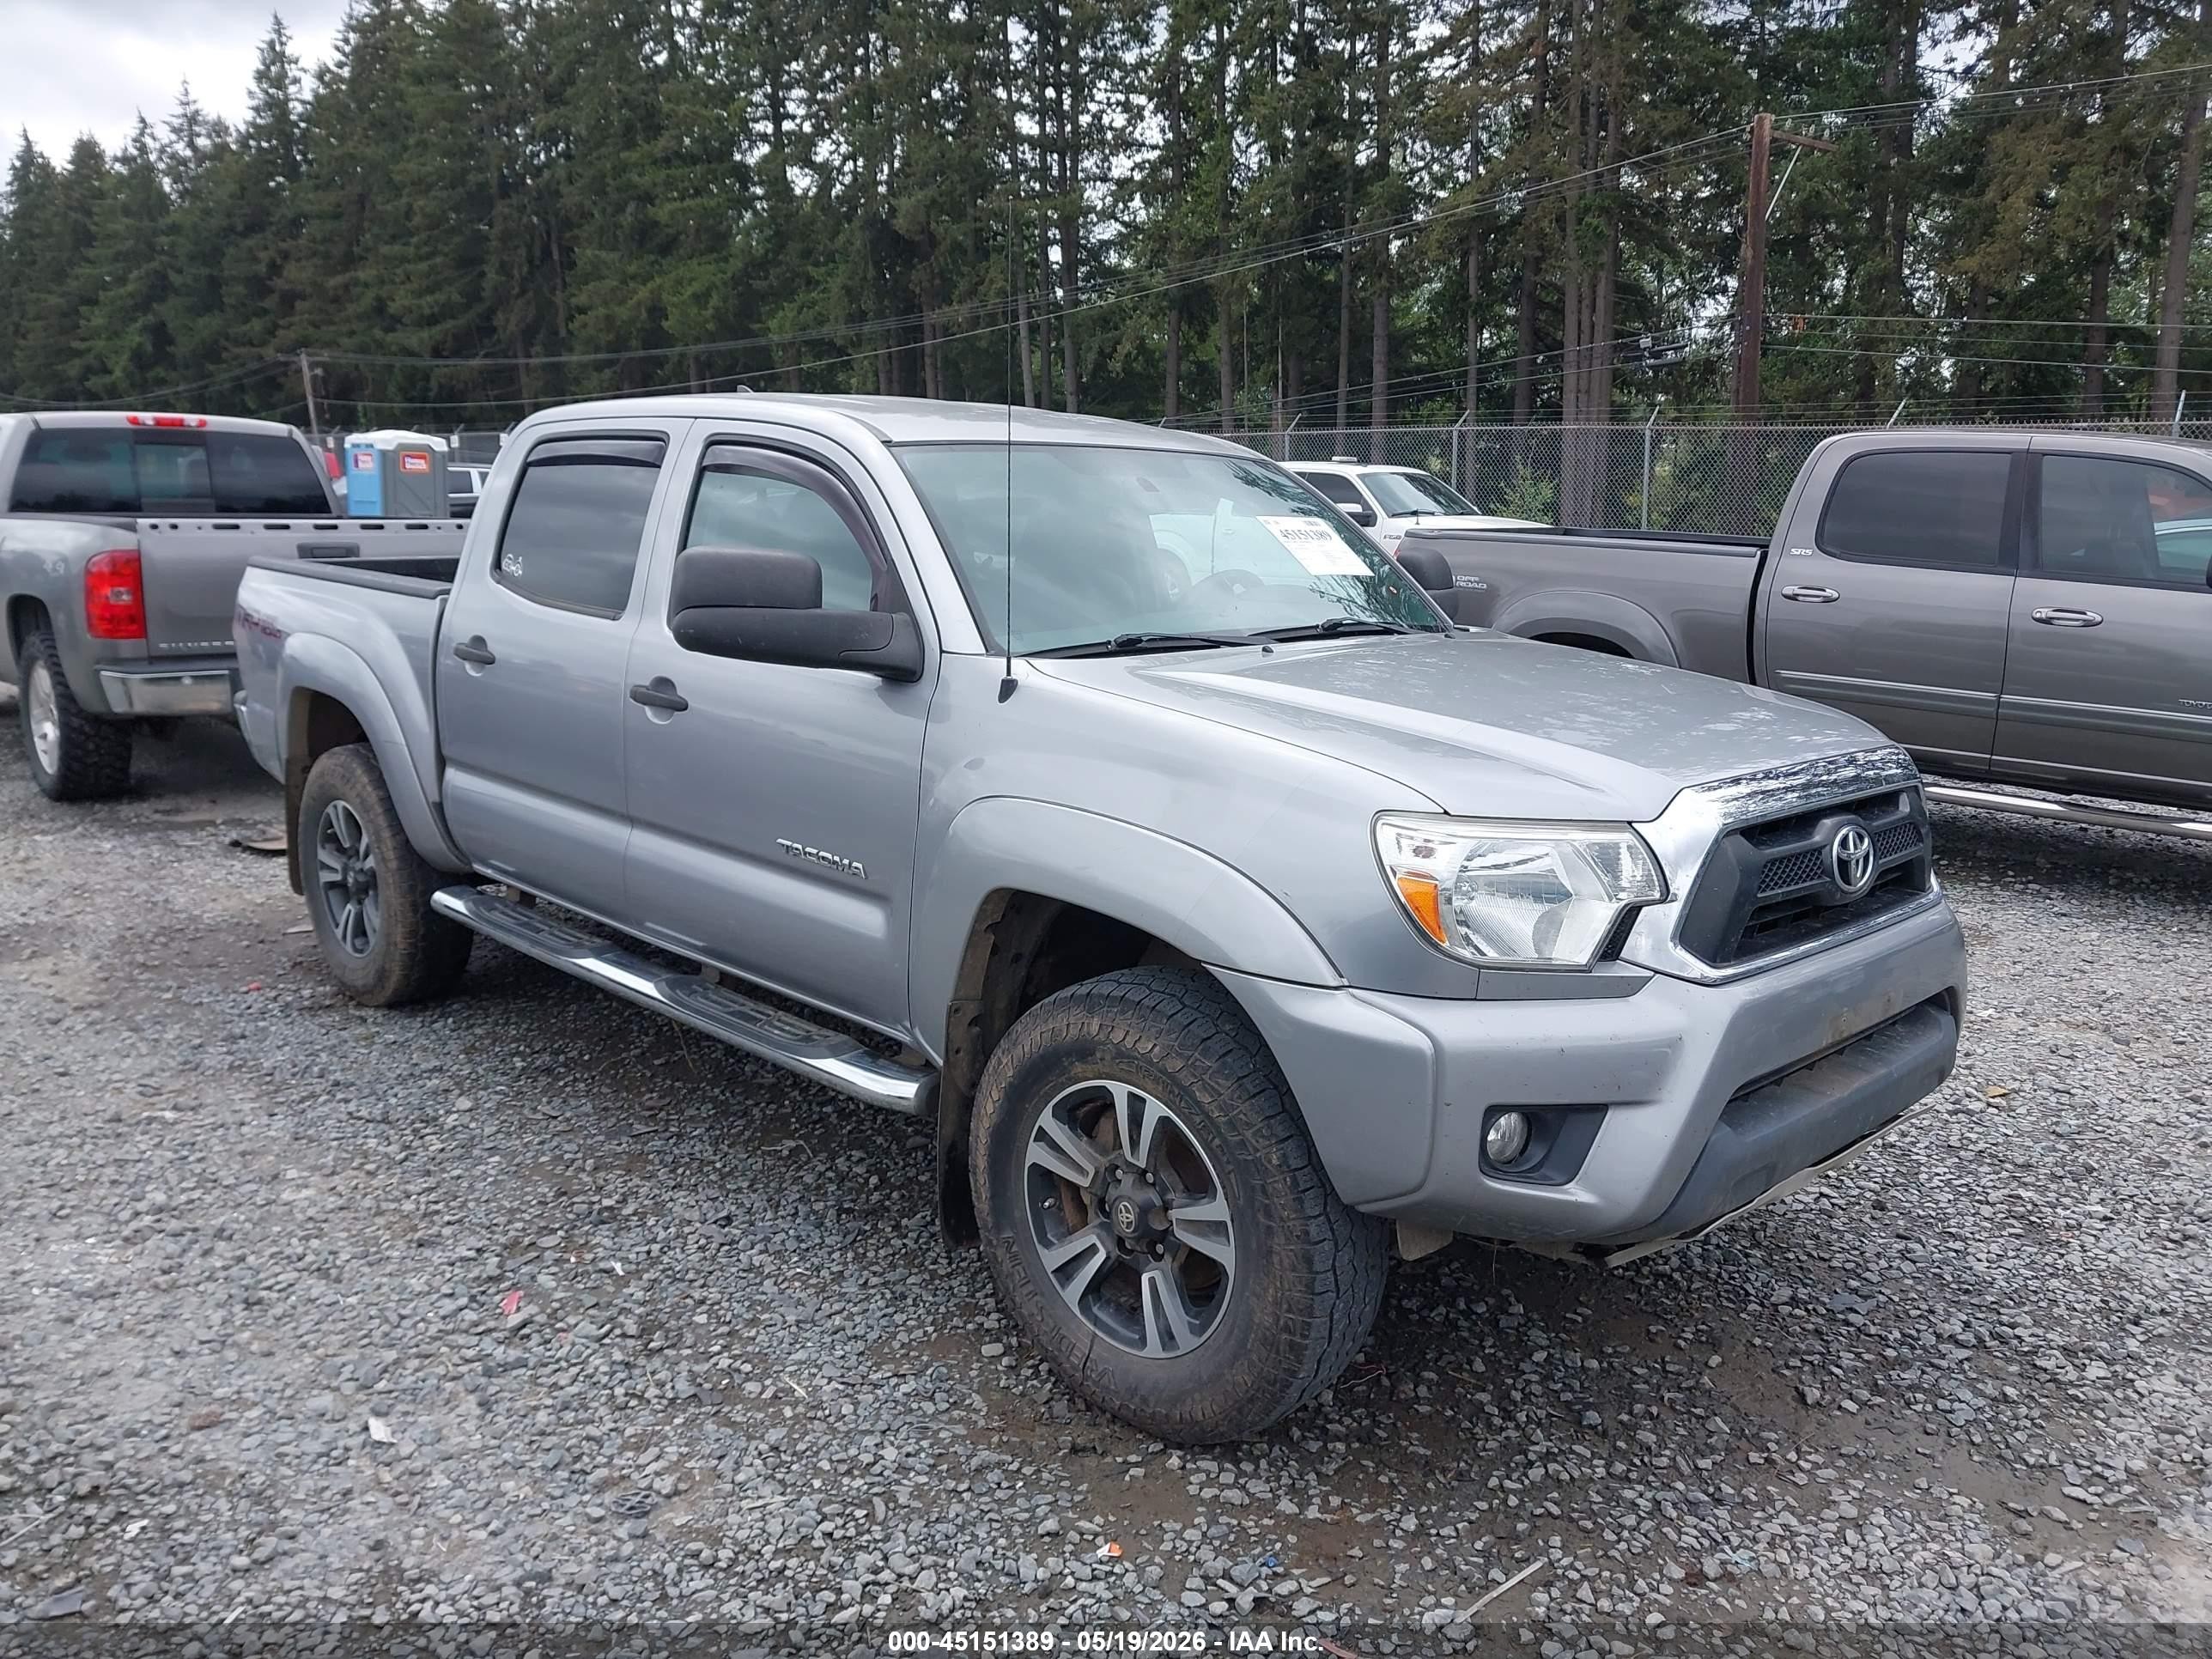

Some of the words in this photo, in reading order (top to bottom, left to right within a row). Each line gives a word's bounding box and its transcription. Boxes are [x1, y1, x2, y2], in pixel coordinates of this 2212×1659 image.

[1279, 528, 1333, 542] 45151389
[1790, 548, 1814, 556] SR5
[775, 837, 869, 880] TACOMA
